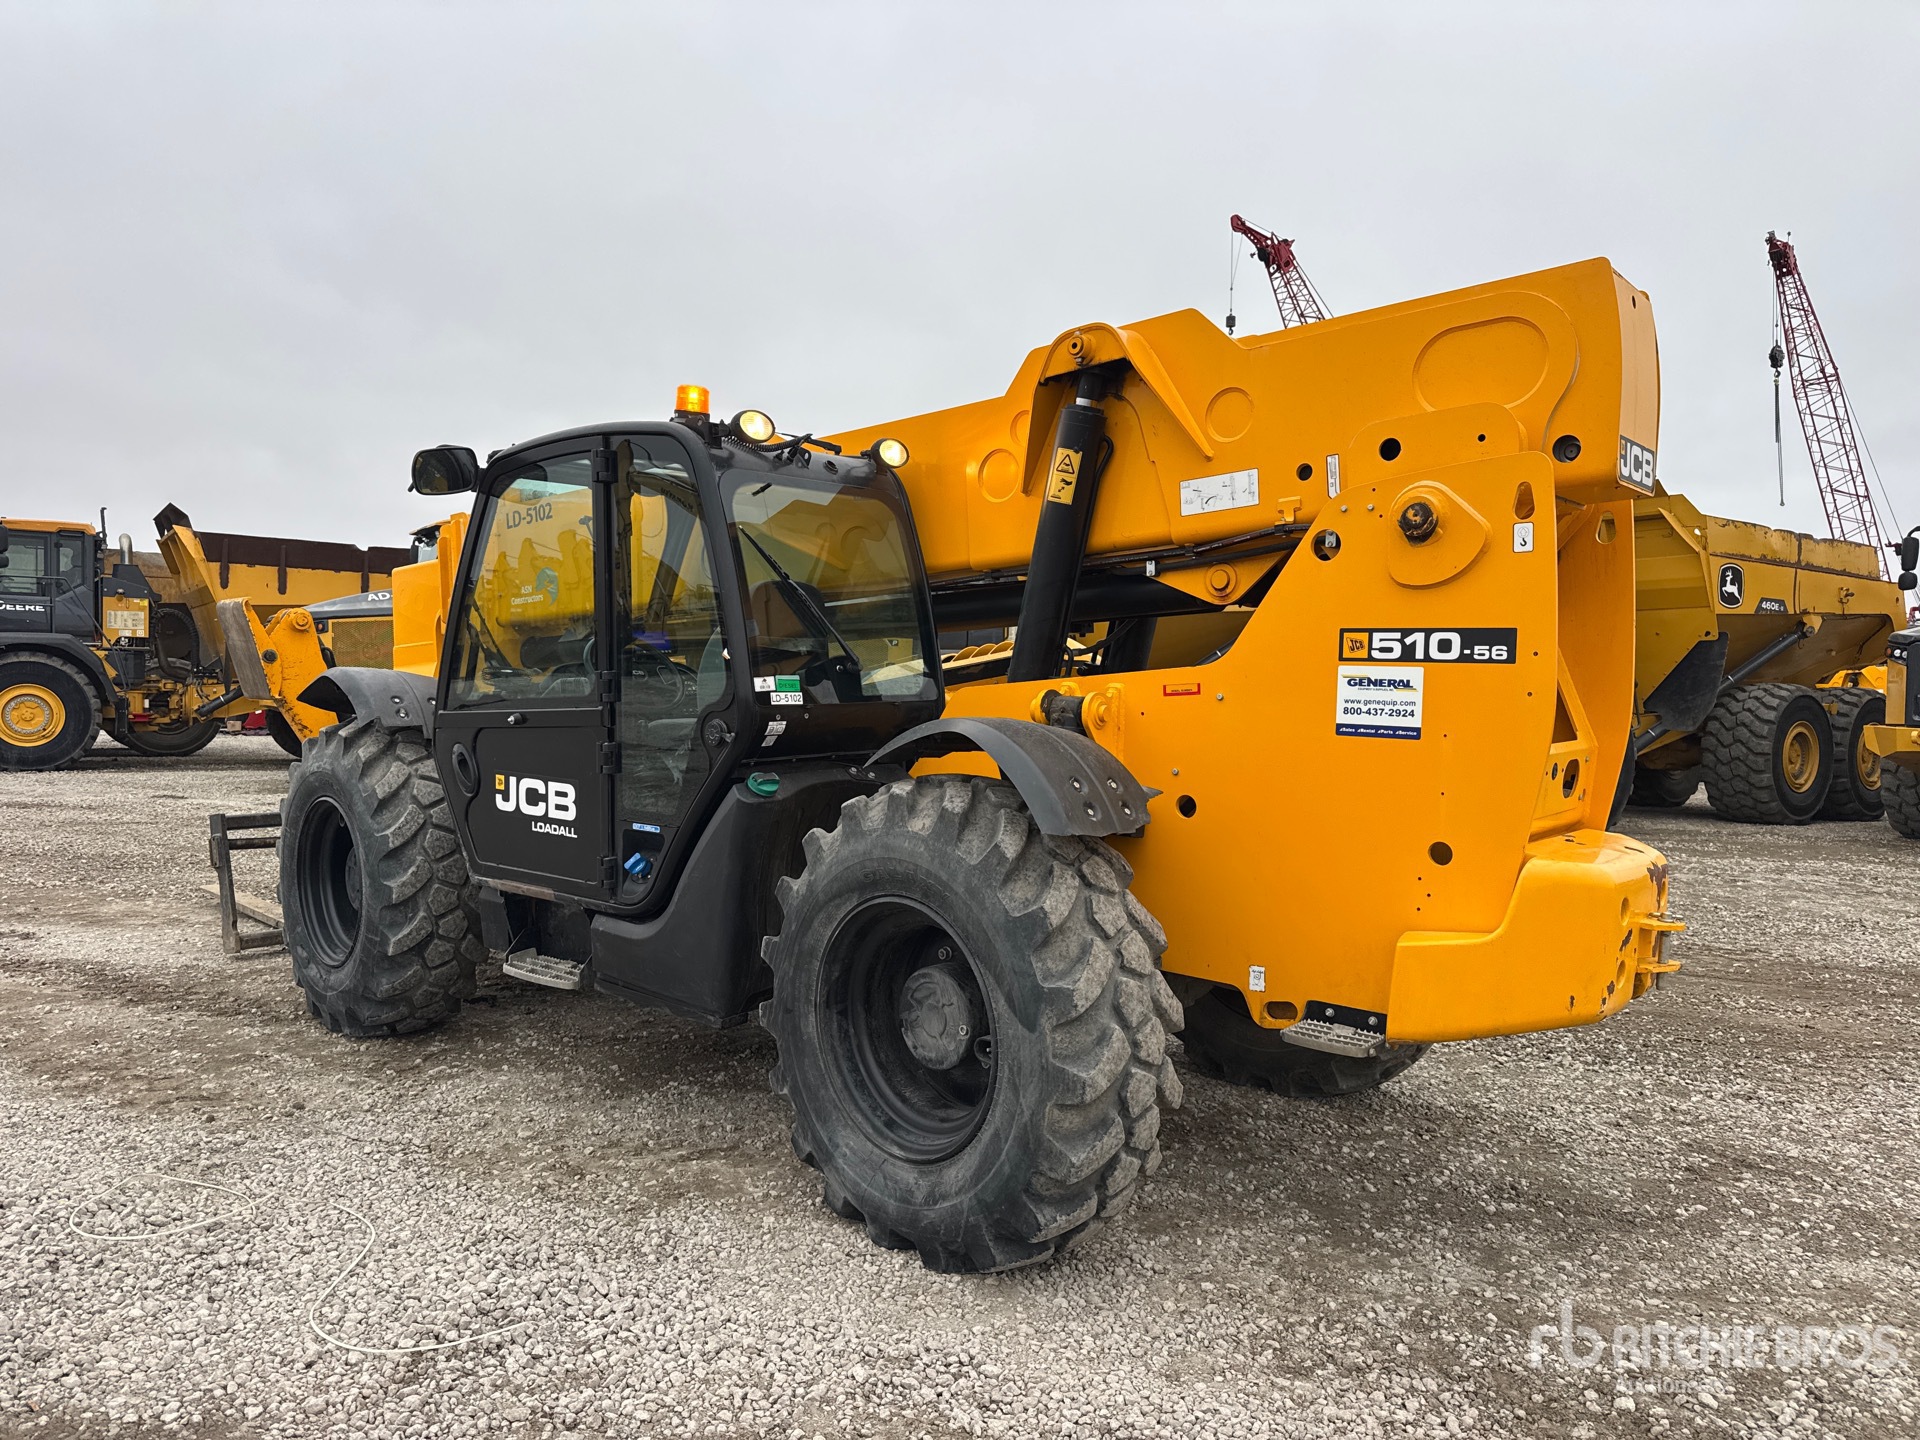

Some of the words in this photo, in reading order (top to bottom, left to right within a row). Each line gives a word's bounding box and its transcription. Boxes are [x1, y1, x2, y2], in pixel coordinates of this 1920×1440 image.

[1620, 439, 1653, 487] JCB
[506, 503, 553, 530] LD-5102
[1371, 632, 1508, 660] 510-56
[1347, 677, 1413, 689] GENERAL
[771, 694, 802, 703] LD-5102
[1343, 698, 1416, 707] www.genequip.com
[1343, 707, 1415, 718] 800-437-2924
[495, 774, 577, 821] JCB
[531, 821, 578, 839] LOADALL
